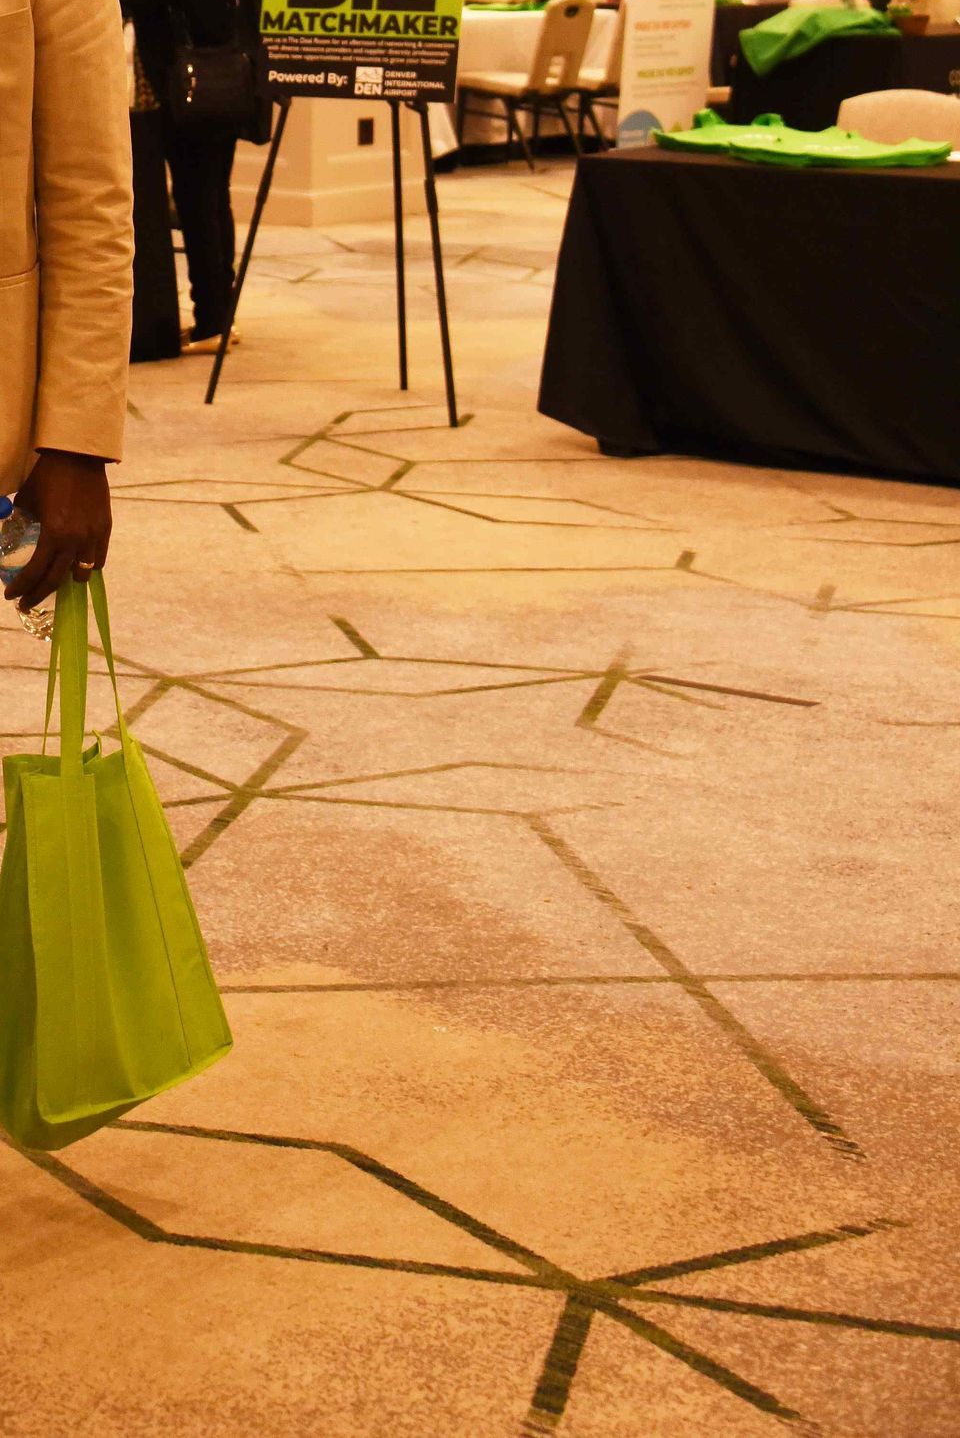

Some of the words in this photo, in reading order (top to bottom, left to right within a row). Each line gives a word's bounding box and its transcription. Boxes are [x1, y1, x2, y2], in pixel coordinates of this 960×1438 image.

[262, 11, 458, 36] MATCHMAKER
[268, 70, 324, 84] Powered
[326, 72, 348, 88] By:
[385, 70, 417, 79] DENVER
[354, 82, 382, 96] DEN
[384, 80, 445, 89] INTERNATIONAL
[383, 89, 417, 97] AIRPORT
